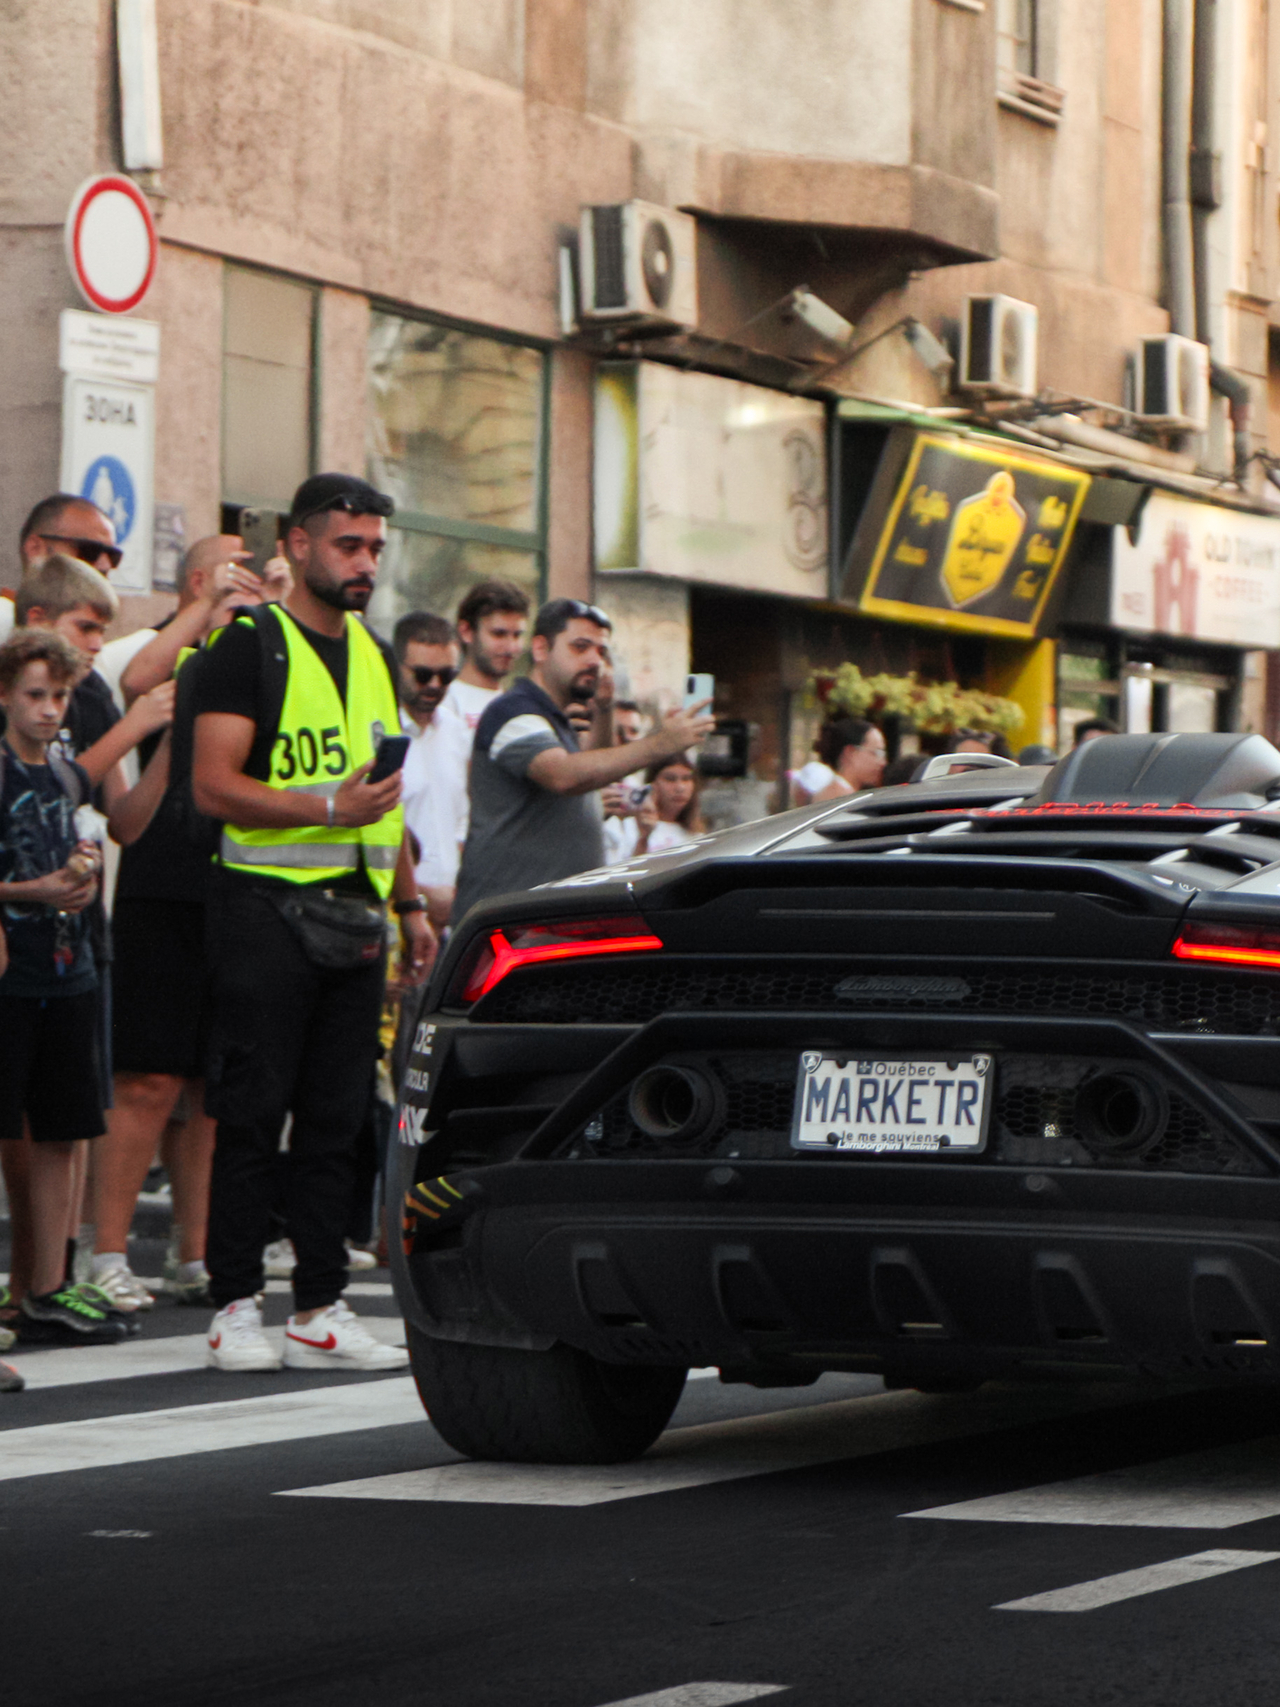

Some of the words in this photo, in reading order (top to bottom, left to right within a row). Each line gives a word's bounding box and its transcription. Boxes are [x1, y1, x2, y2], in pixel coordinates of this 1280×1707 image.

[86, 394, 137, 425] ЗОНА
[277, 725, 347, 781] 305
[874, 1062, 936, 1076] Québec
[805, 1076, 979, 1126] MARKETR
[836, 1140, 902, 1153] Lamborghini
[839, 1130, 853, 1143] Je
[858, 1132, 877, 1142] me
[881, 1131, 940, 1143] souviens
